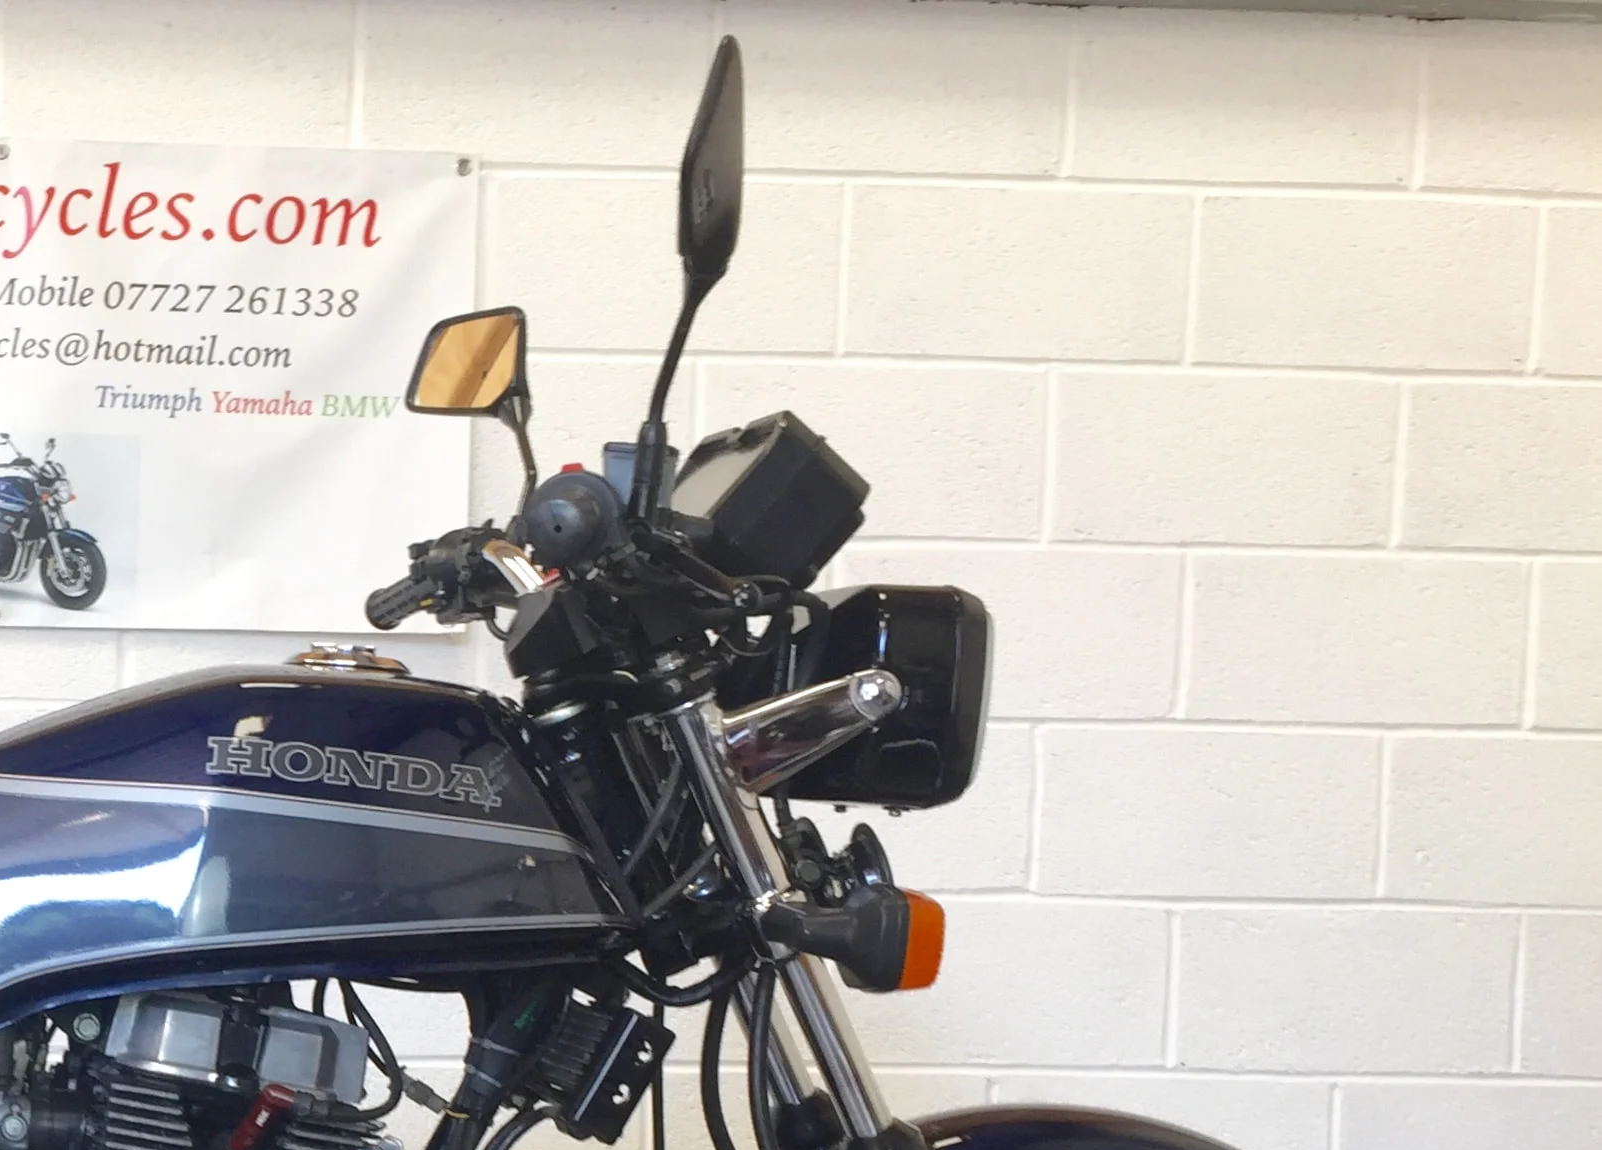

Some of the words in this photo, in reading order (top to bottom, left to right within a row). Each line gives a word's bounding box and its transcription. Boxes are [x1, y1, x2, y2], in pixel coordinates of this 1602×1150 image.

[103, 280, 217, 313] 07727
[223, 284, 360, 318] 261338
[96, 384, 203, 419] Triumph
[210, 389, 314, 417] Yamaha
[320, 393, 402, 418] BMW
[205, 735, 503, 809] HONDA
